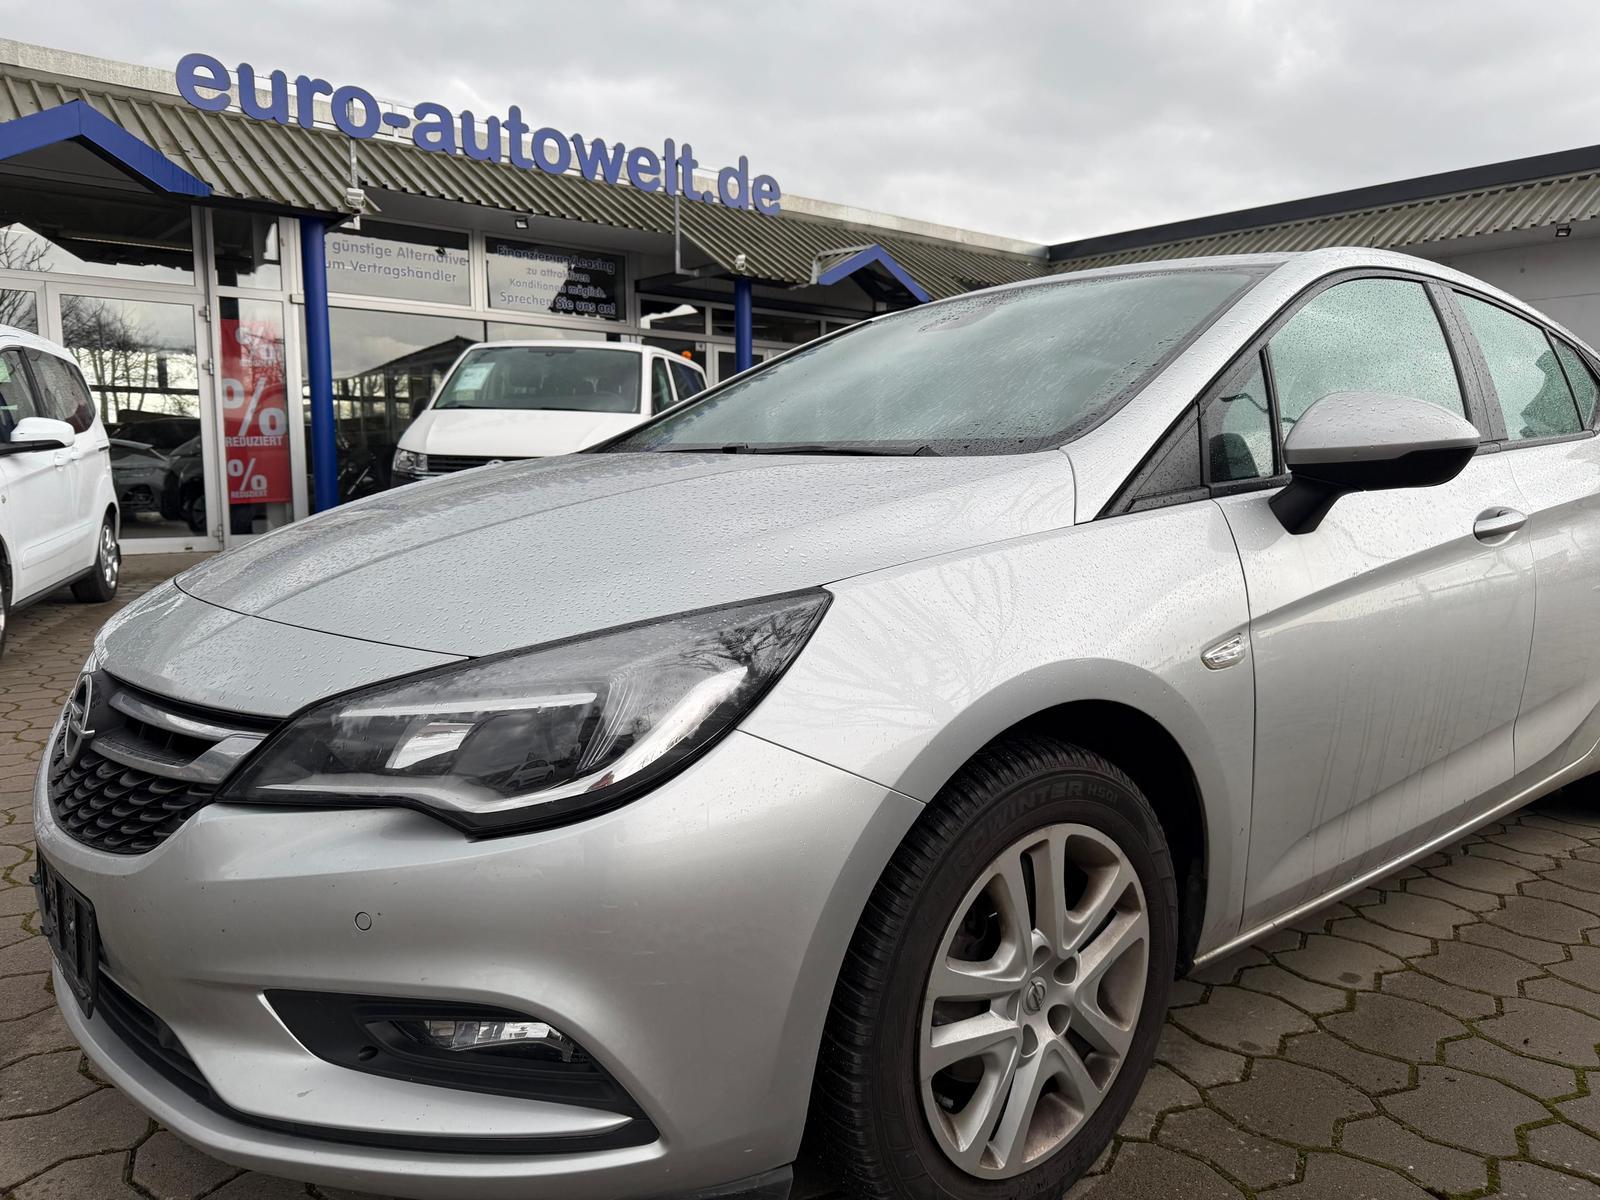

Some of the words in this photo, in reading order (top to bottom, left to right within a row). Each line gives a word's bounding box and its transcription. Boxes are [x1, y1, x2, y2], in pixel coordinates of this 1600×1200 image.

[175, 53, 781, 216] euro-autowelt.de
[332, 239, 392, 258] günstige
[397, 246, 466, 266] Alternative
[496, 245, 615, 275] Finanzierung/Leasing
[350, 259, 457, 283] Vertragshändler
[527, 267, 537, 276] zu
[540, 268, 590, 283] attraktiven
[510, 277, 567, 294] Konditionen
[500, 290, 553, 307] Sprechen
[555, 296, 574, 310] Sie
[575, 301, 596, 312] uns
[597, 302, 616, 315] an!
[222, 377, 287, 436] %
[224, 435, 282, 447] REDUZIERT
[227, 458, 267, 491] %
